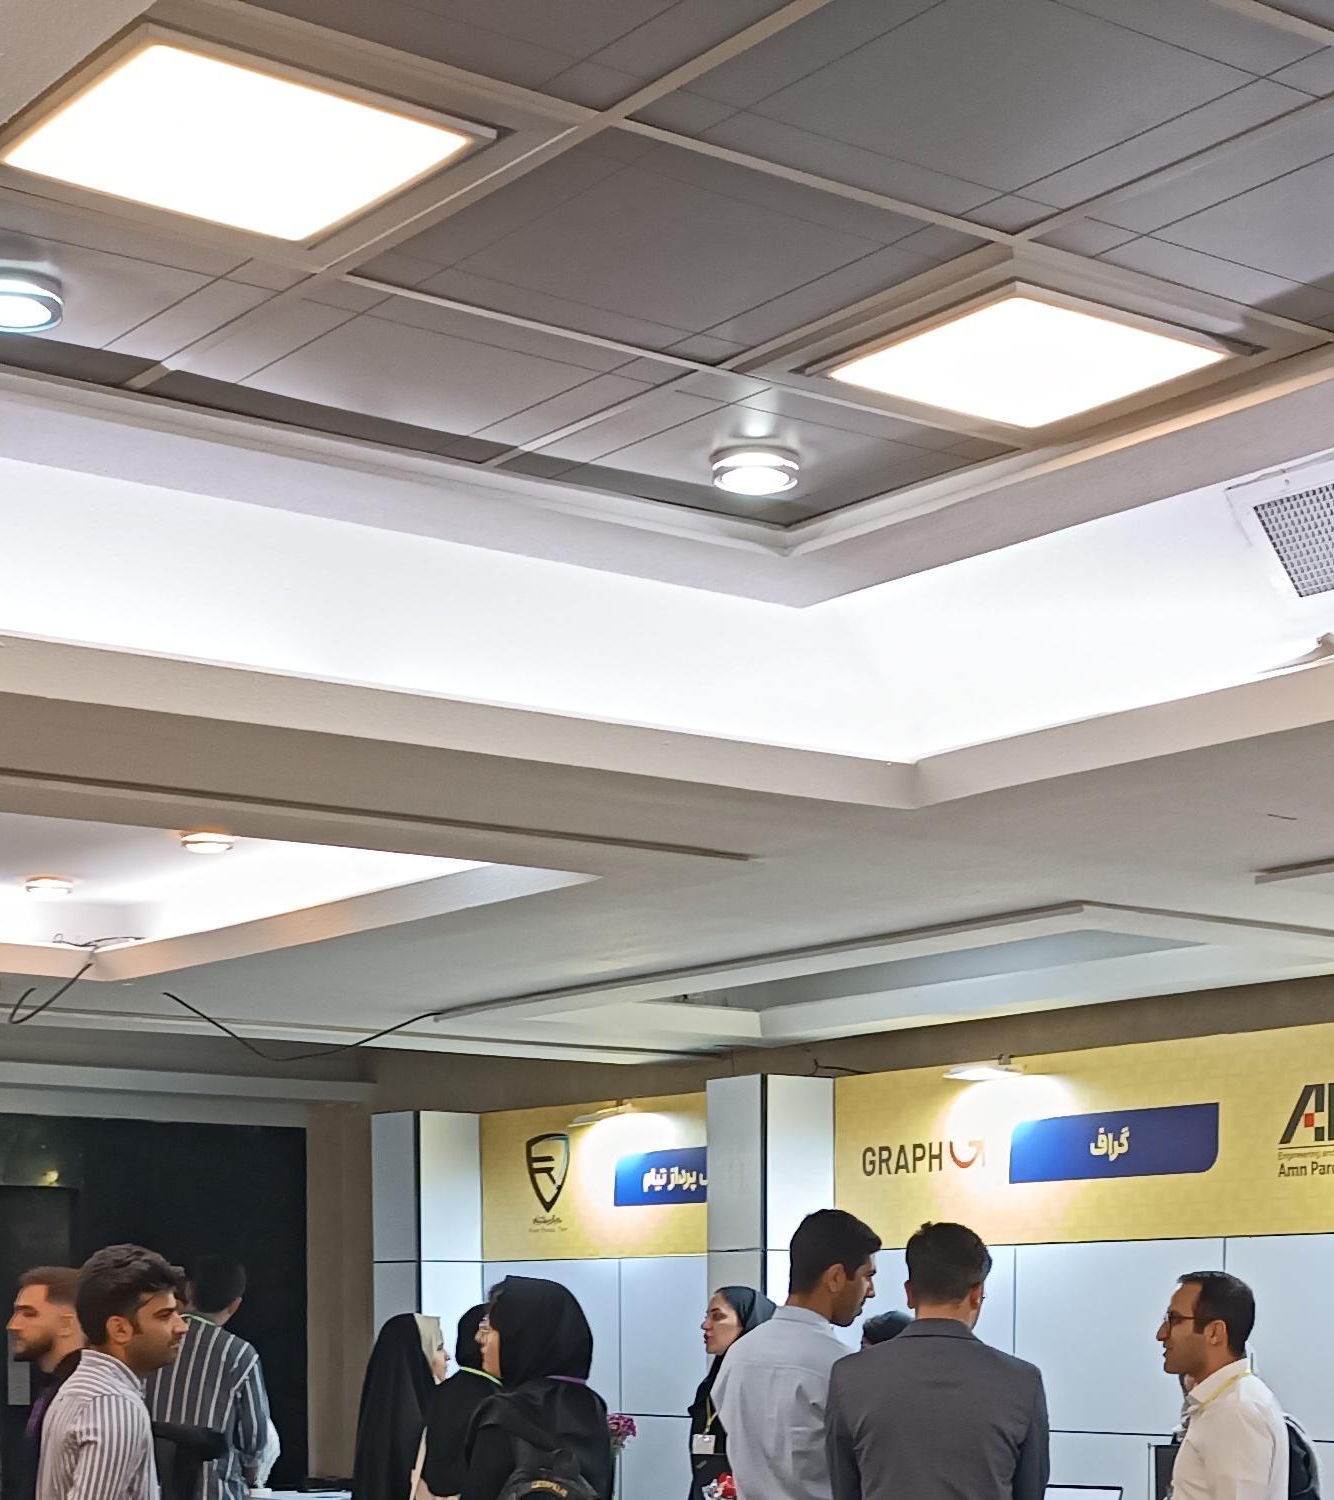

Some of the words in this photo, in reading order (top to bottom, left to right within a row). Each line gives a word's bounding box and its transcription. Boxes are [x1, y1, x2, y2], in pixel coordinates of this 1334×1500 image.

[862, 1141, 943, 1176] GRAPH
[1089, 1126, 1130, 1162] گراف
[667, 1166, 697, 1191] پرداز
[1278, 1162, 1307, 1178] Amn
